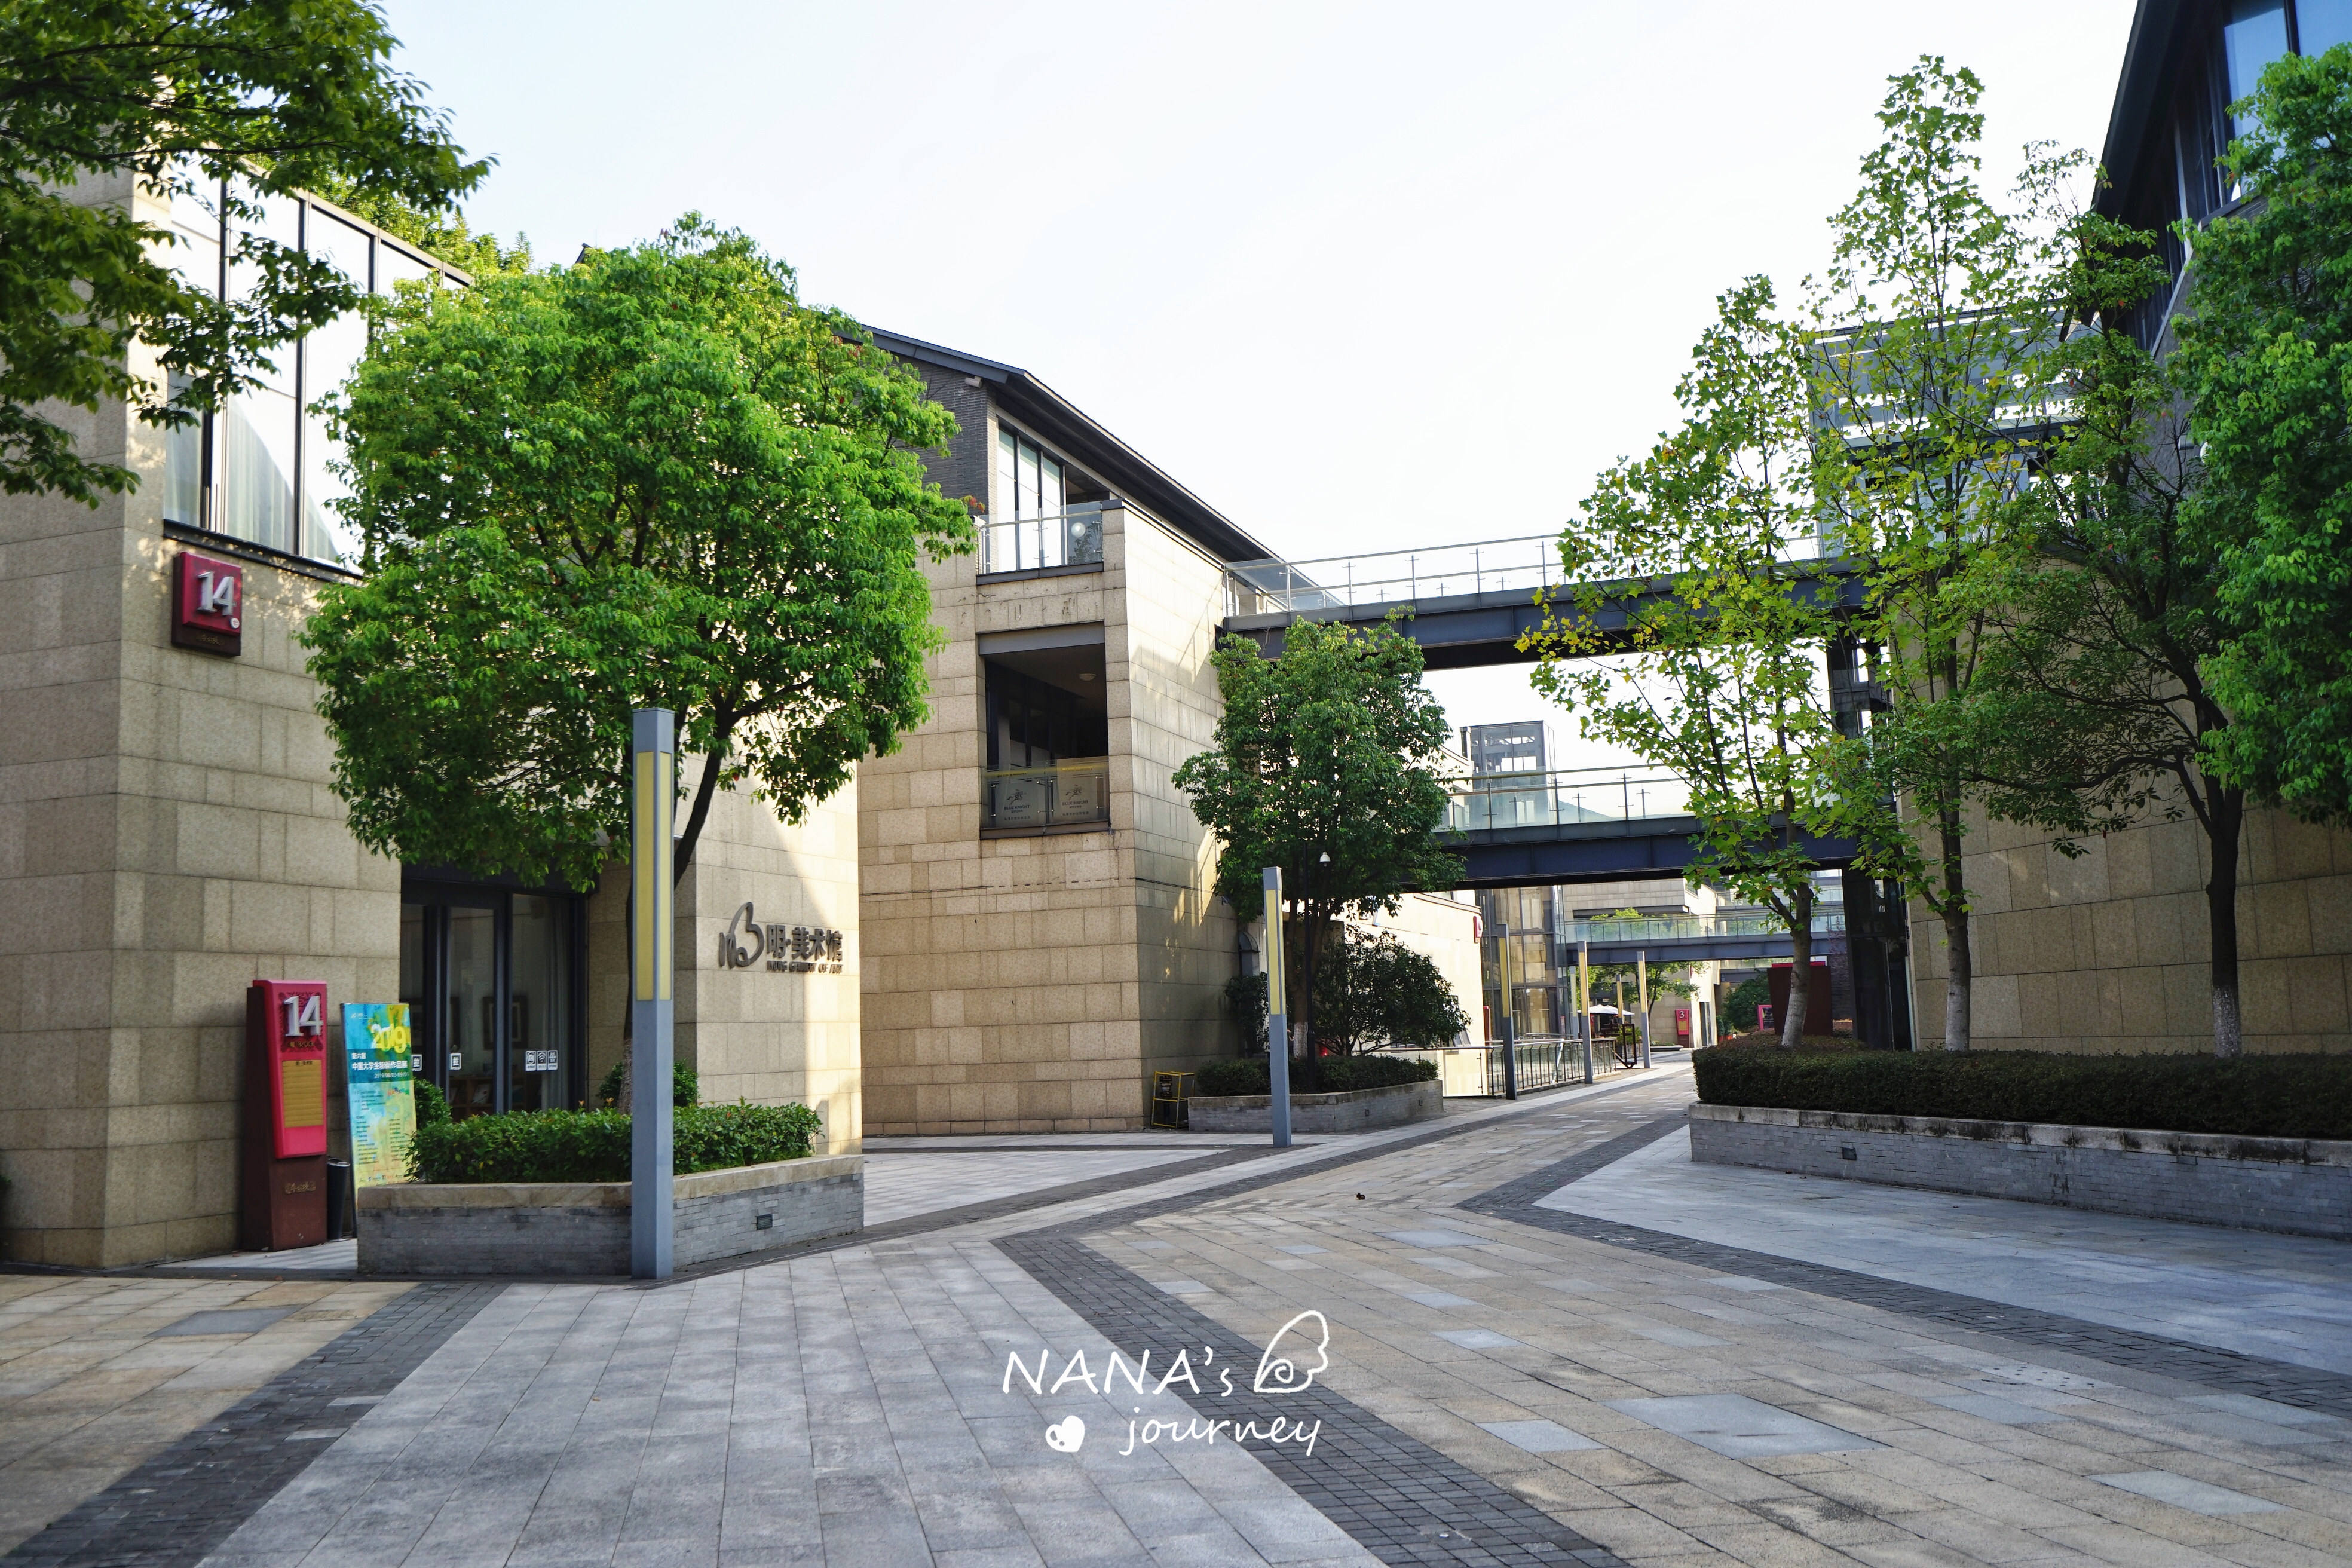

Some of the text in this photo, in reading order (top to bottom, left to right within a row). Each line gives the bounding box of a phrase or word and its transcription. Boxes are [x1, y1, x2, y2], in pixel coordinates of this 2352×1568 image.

[197, 571, 237, 616] 14
[283, 996, 324, 1037] 14
[370, 1023, 407, 1054] 2019
